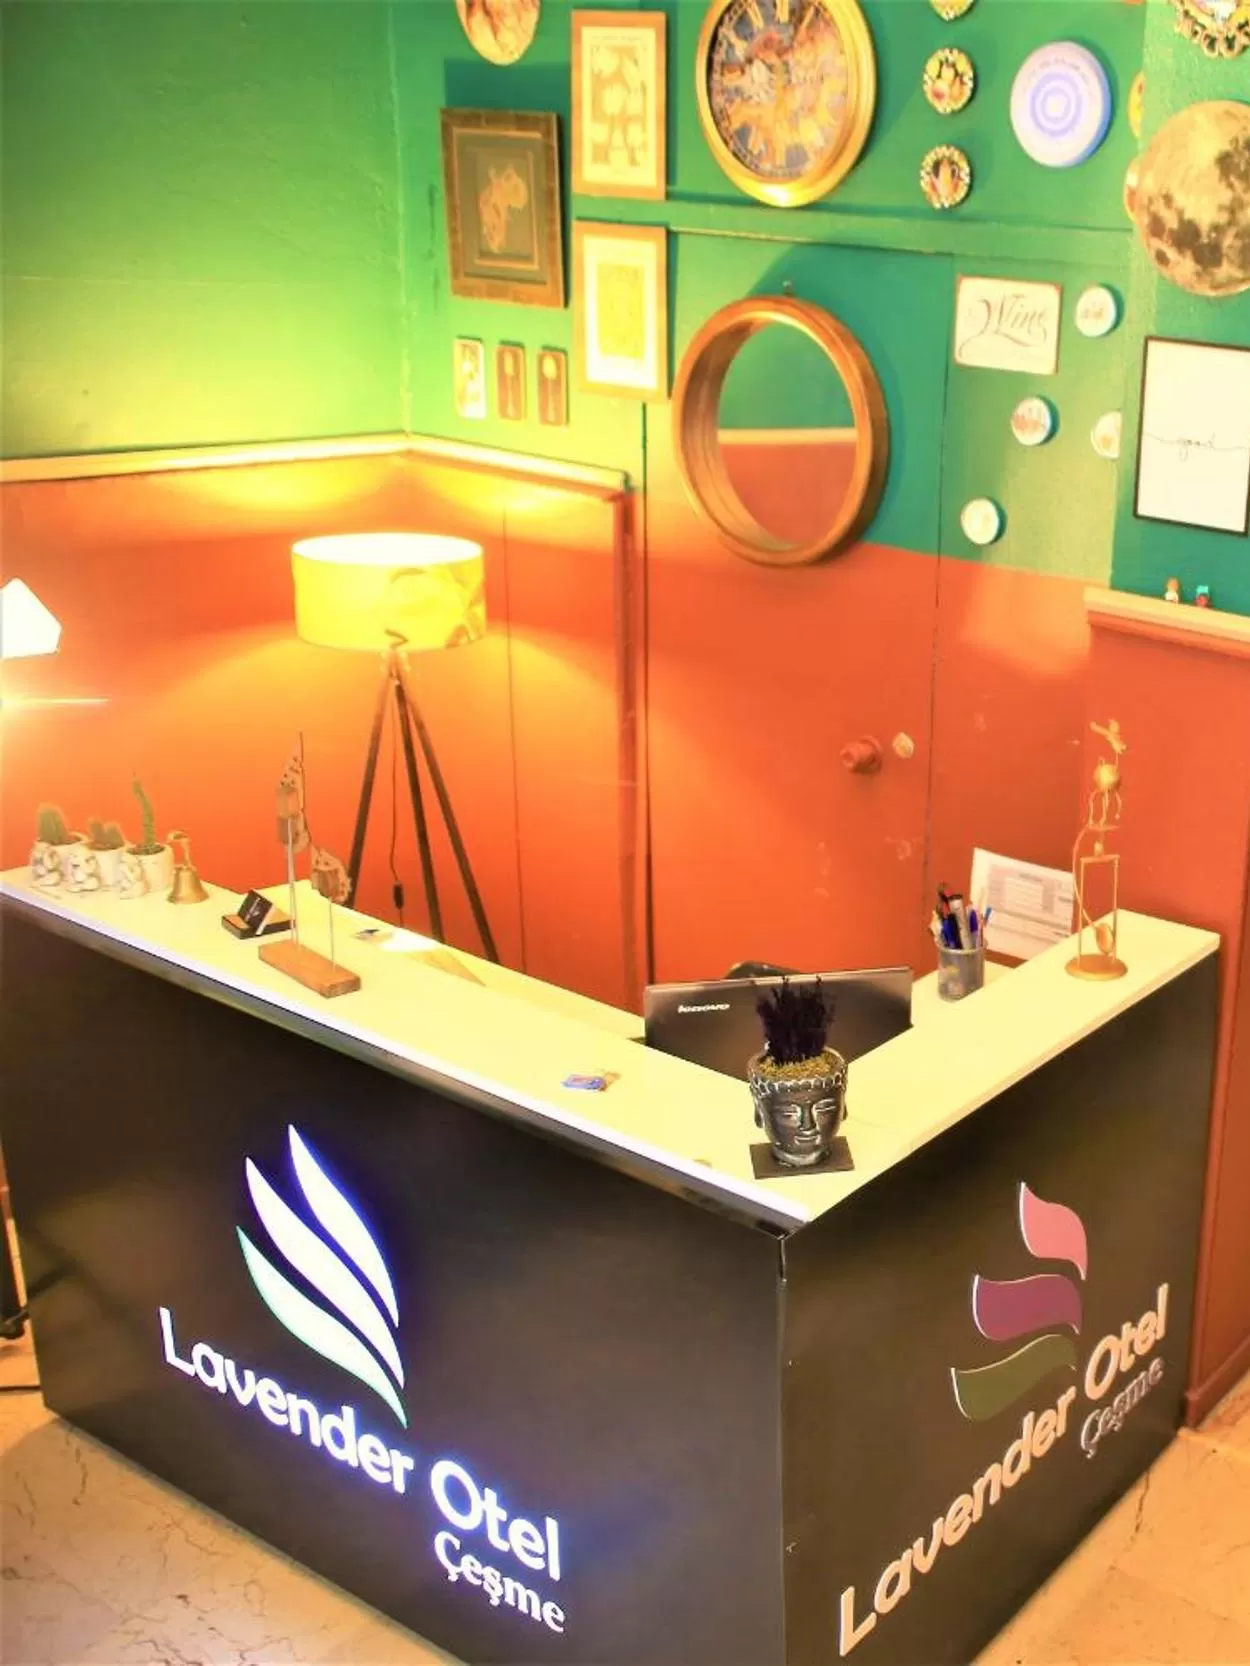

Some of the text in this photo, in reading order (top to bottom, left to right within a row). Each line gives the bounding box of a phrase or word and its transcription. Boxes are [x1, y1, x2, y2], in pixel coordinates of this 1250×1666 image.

[958, 293, 1048, 358] Wine
[159, 1305, 562, 1581] Lavender Otel
[1080, 1357, 1165, 1459] Çeşme
[839, 1283, 1169, 1657] Lavender Otel
[433, 1531, 566, 1633] Çeşme
